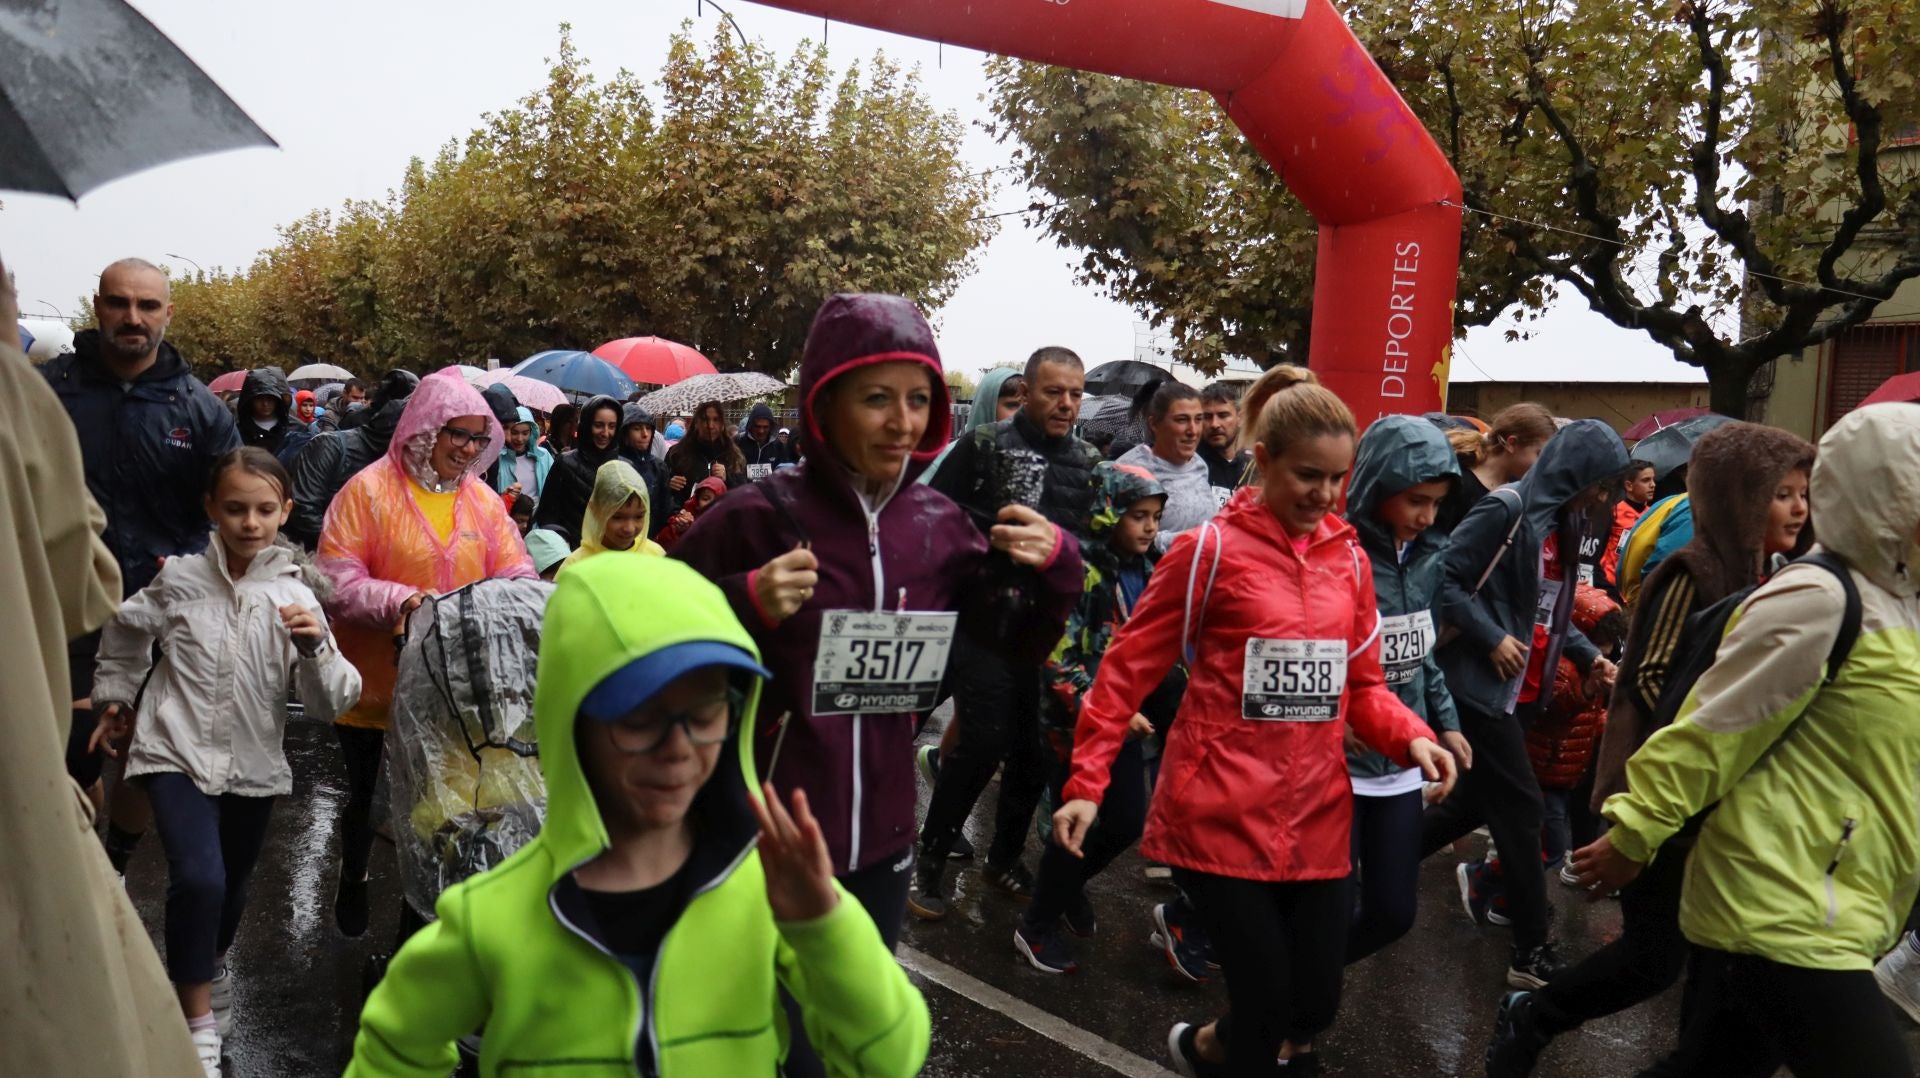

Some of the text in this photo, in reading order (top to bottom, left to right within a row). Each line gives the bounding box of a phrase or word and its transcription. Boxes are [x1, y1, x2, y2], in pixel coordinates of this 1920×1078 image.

[1381, 242, 1420, 398] DEPORTES
[845, 640, 925, 681] 3517
[1385, 629, 1425, 661] 3291
[1262, 660, 1332, 694] 3538
[860, 694, 919, 707] HYUNDAI
[1284, 705, 1331, 715] HYUNDAI
